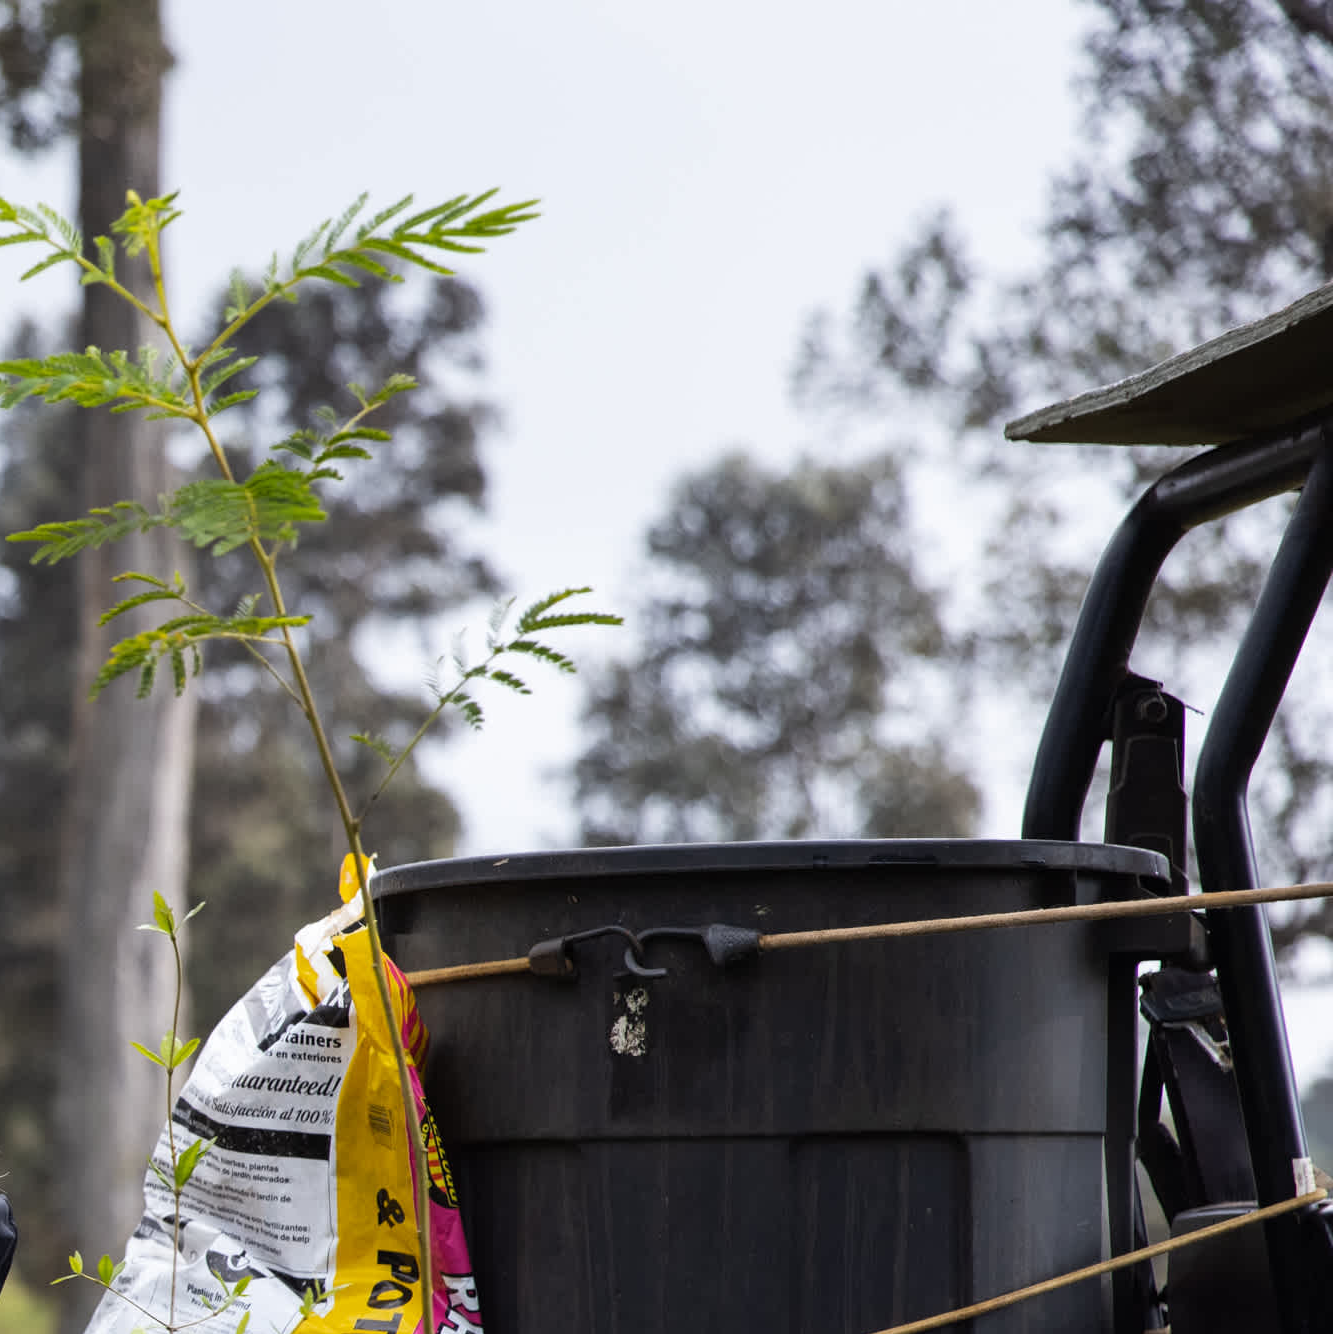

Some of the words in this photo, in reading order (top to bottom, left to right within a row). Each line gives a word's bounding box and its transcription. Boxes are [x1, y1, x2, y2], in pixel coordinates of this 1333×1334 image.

[283, 1029, 342, 1049] tainers
[291, 1052, 342, 1064] exteriores
[232, 1073, 342, 1097] uaranteed!
[281, 1108, 293, 1121] al
[377, 1188, 405, 1229] &
